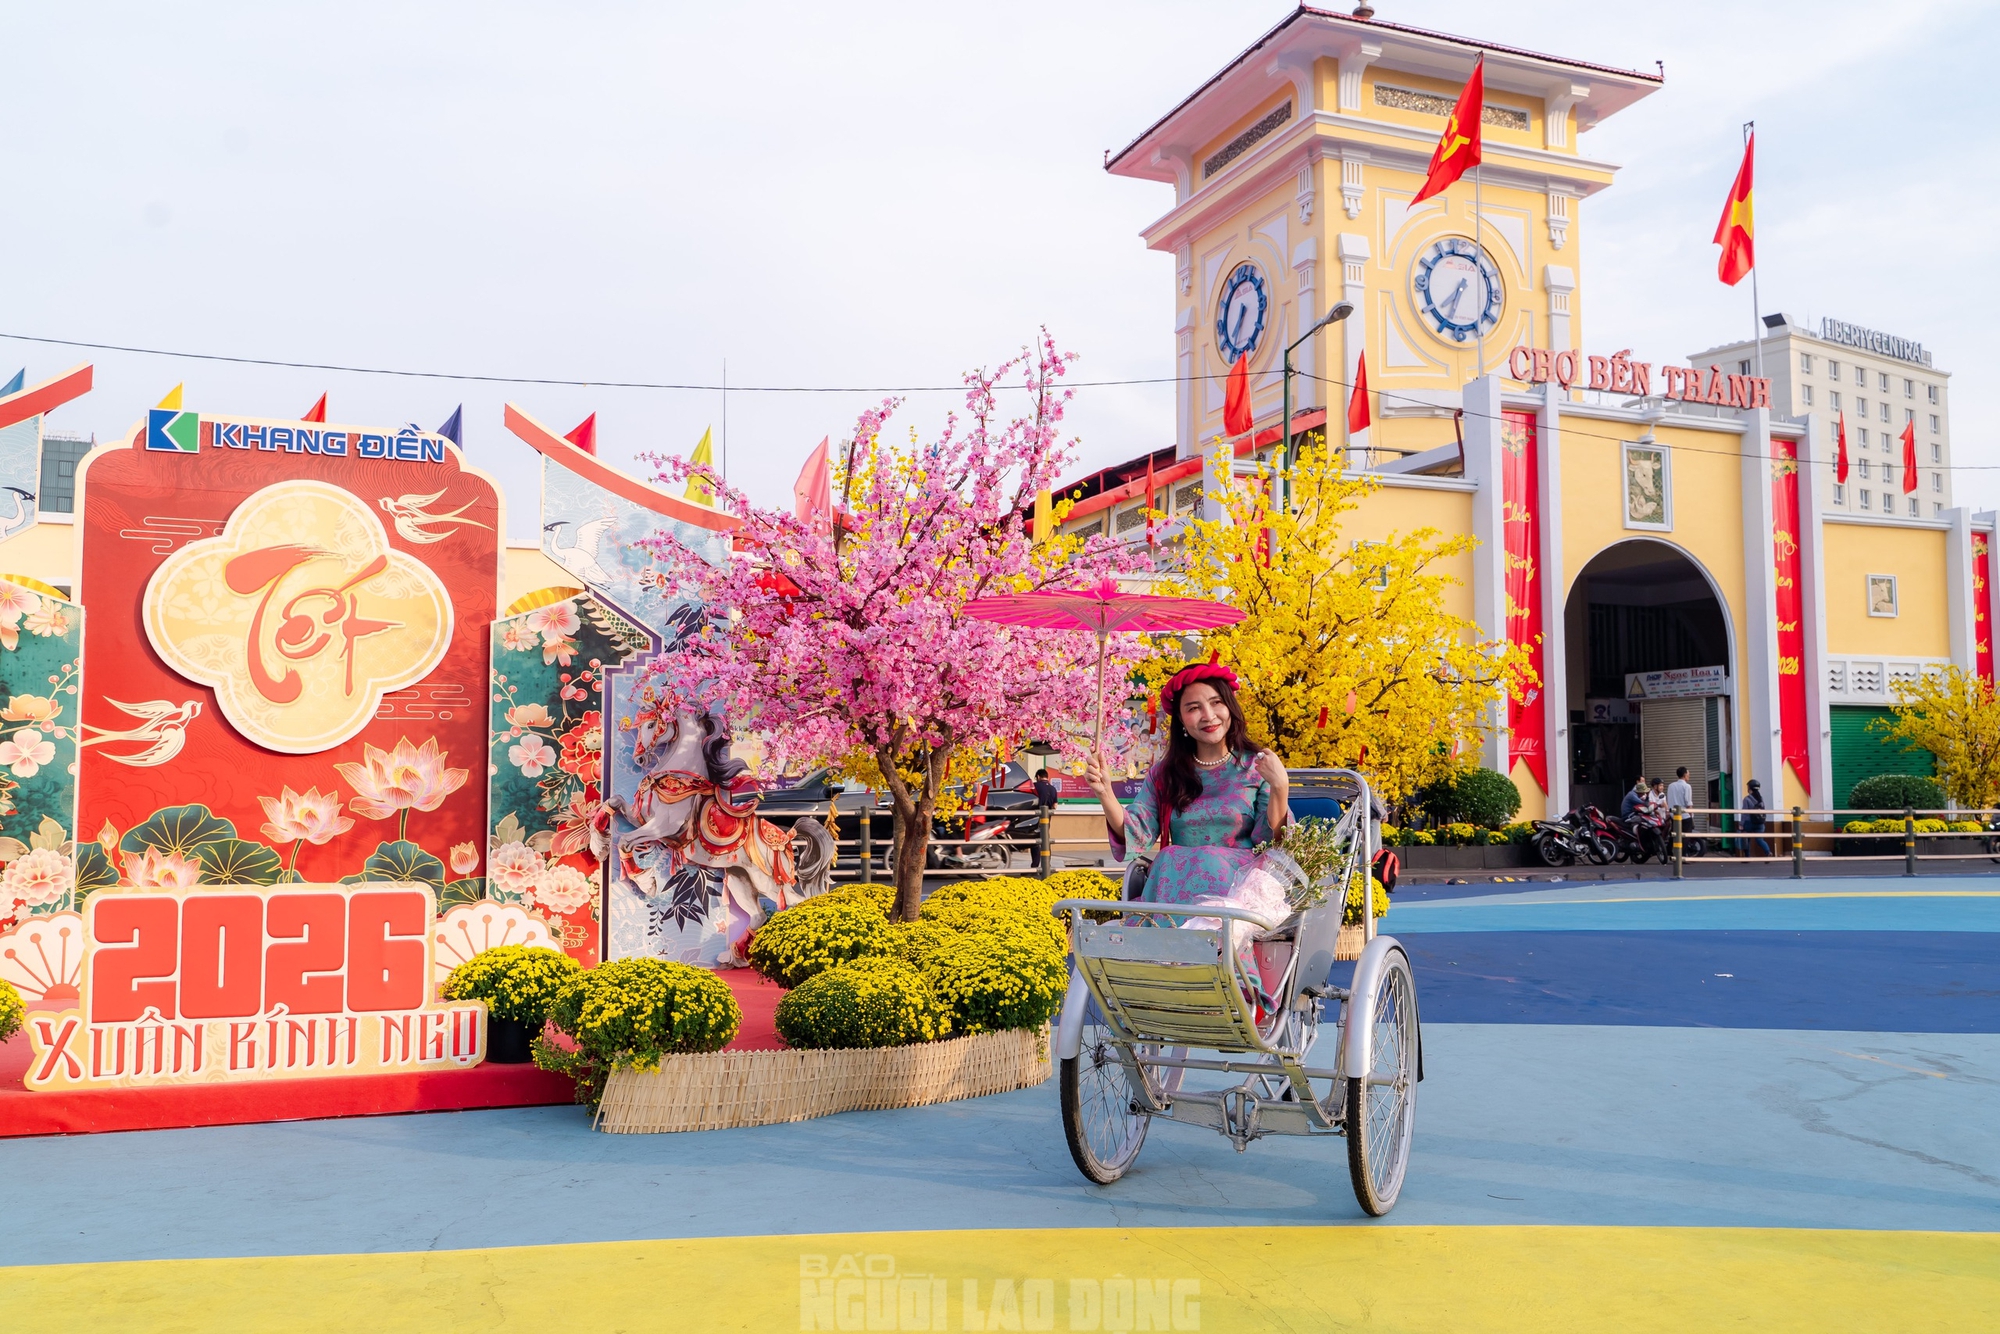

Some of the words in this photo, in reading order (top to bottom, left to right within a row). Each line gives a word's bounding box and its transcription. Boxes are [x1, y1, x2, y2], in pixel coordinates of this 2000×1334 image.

[1822, 316, 1874, 350] LIBERTY
[1509, 346, 1580, 391] CHỢ
[1588, 348, 1652, 396] BẾN
[1662, 363, 1774, 410] THÀNH
[213, 421, 348, 457] KHANG
[357, 421, 445, 463] ĐIỀN
[1775, 614, 1798, 632] ear
[1690, 668, 1712, 678] Hoa
[1776, 656, 1800, 676] 026
[91, 891, 427, 1024] 2026
[35, 1010, 203, 1081] XUÂN
[229, 1006, 358, 1071] BÍNH
[381, 1009, 478, 1064] NGỌ
